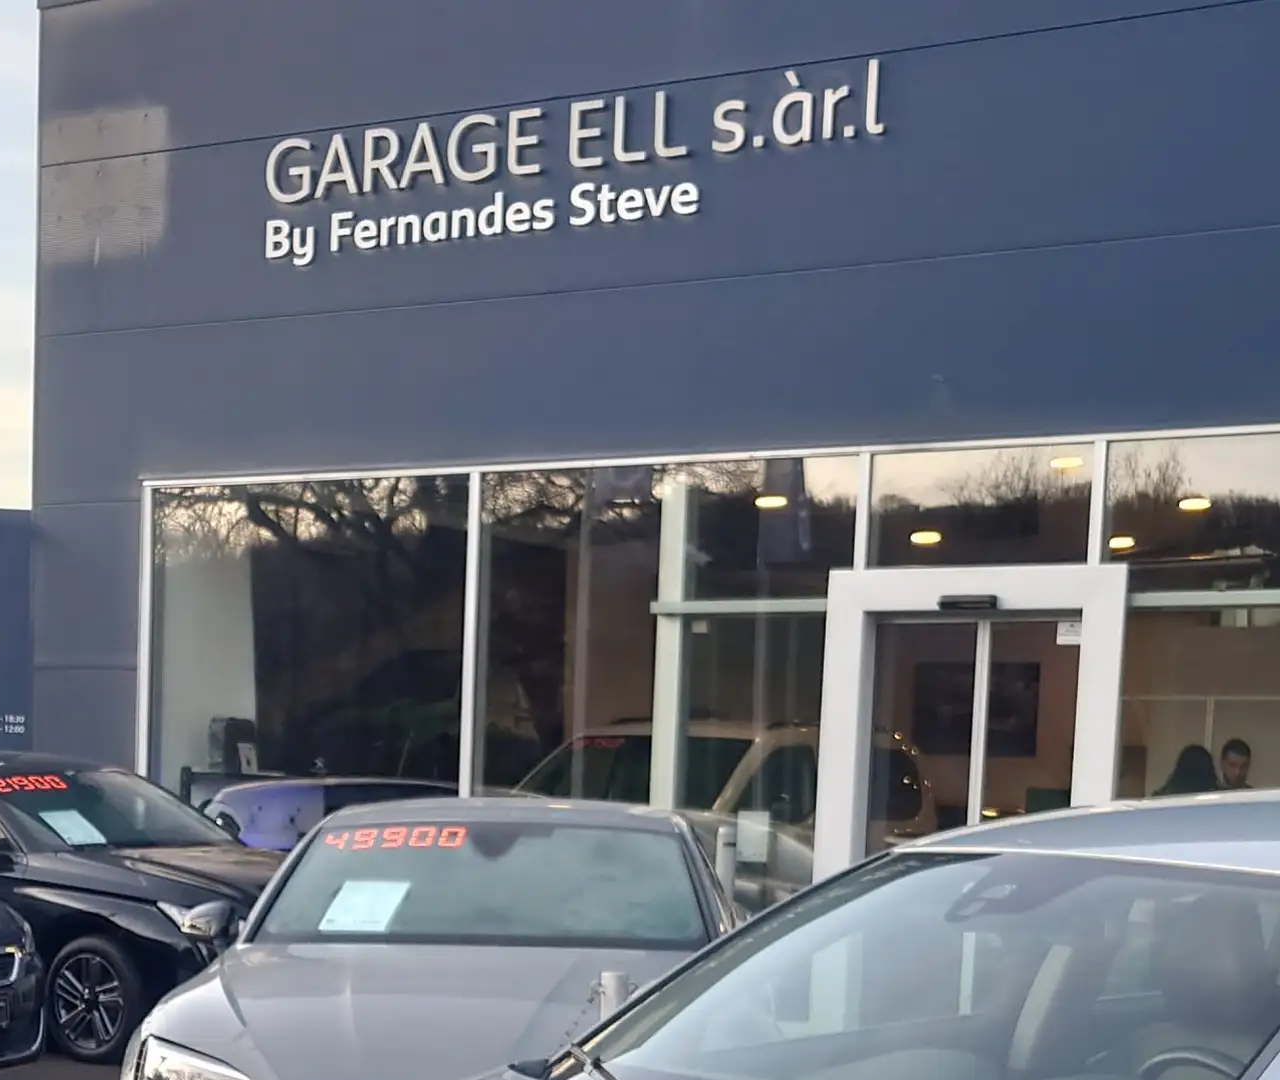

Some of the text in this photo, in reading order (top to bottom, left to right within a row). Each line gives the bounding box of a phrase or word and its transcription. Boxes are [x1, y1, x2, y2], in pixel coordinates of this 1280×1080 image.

[266, 58, 887, 204] GARAGE ELL s.àr.l
[264, 181, 700, 267] By Fernandes Steve
[324, 825, 468, 851] 49900
